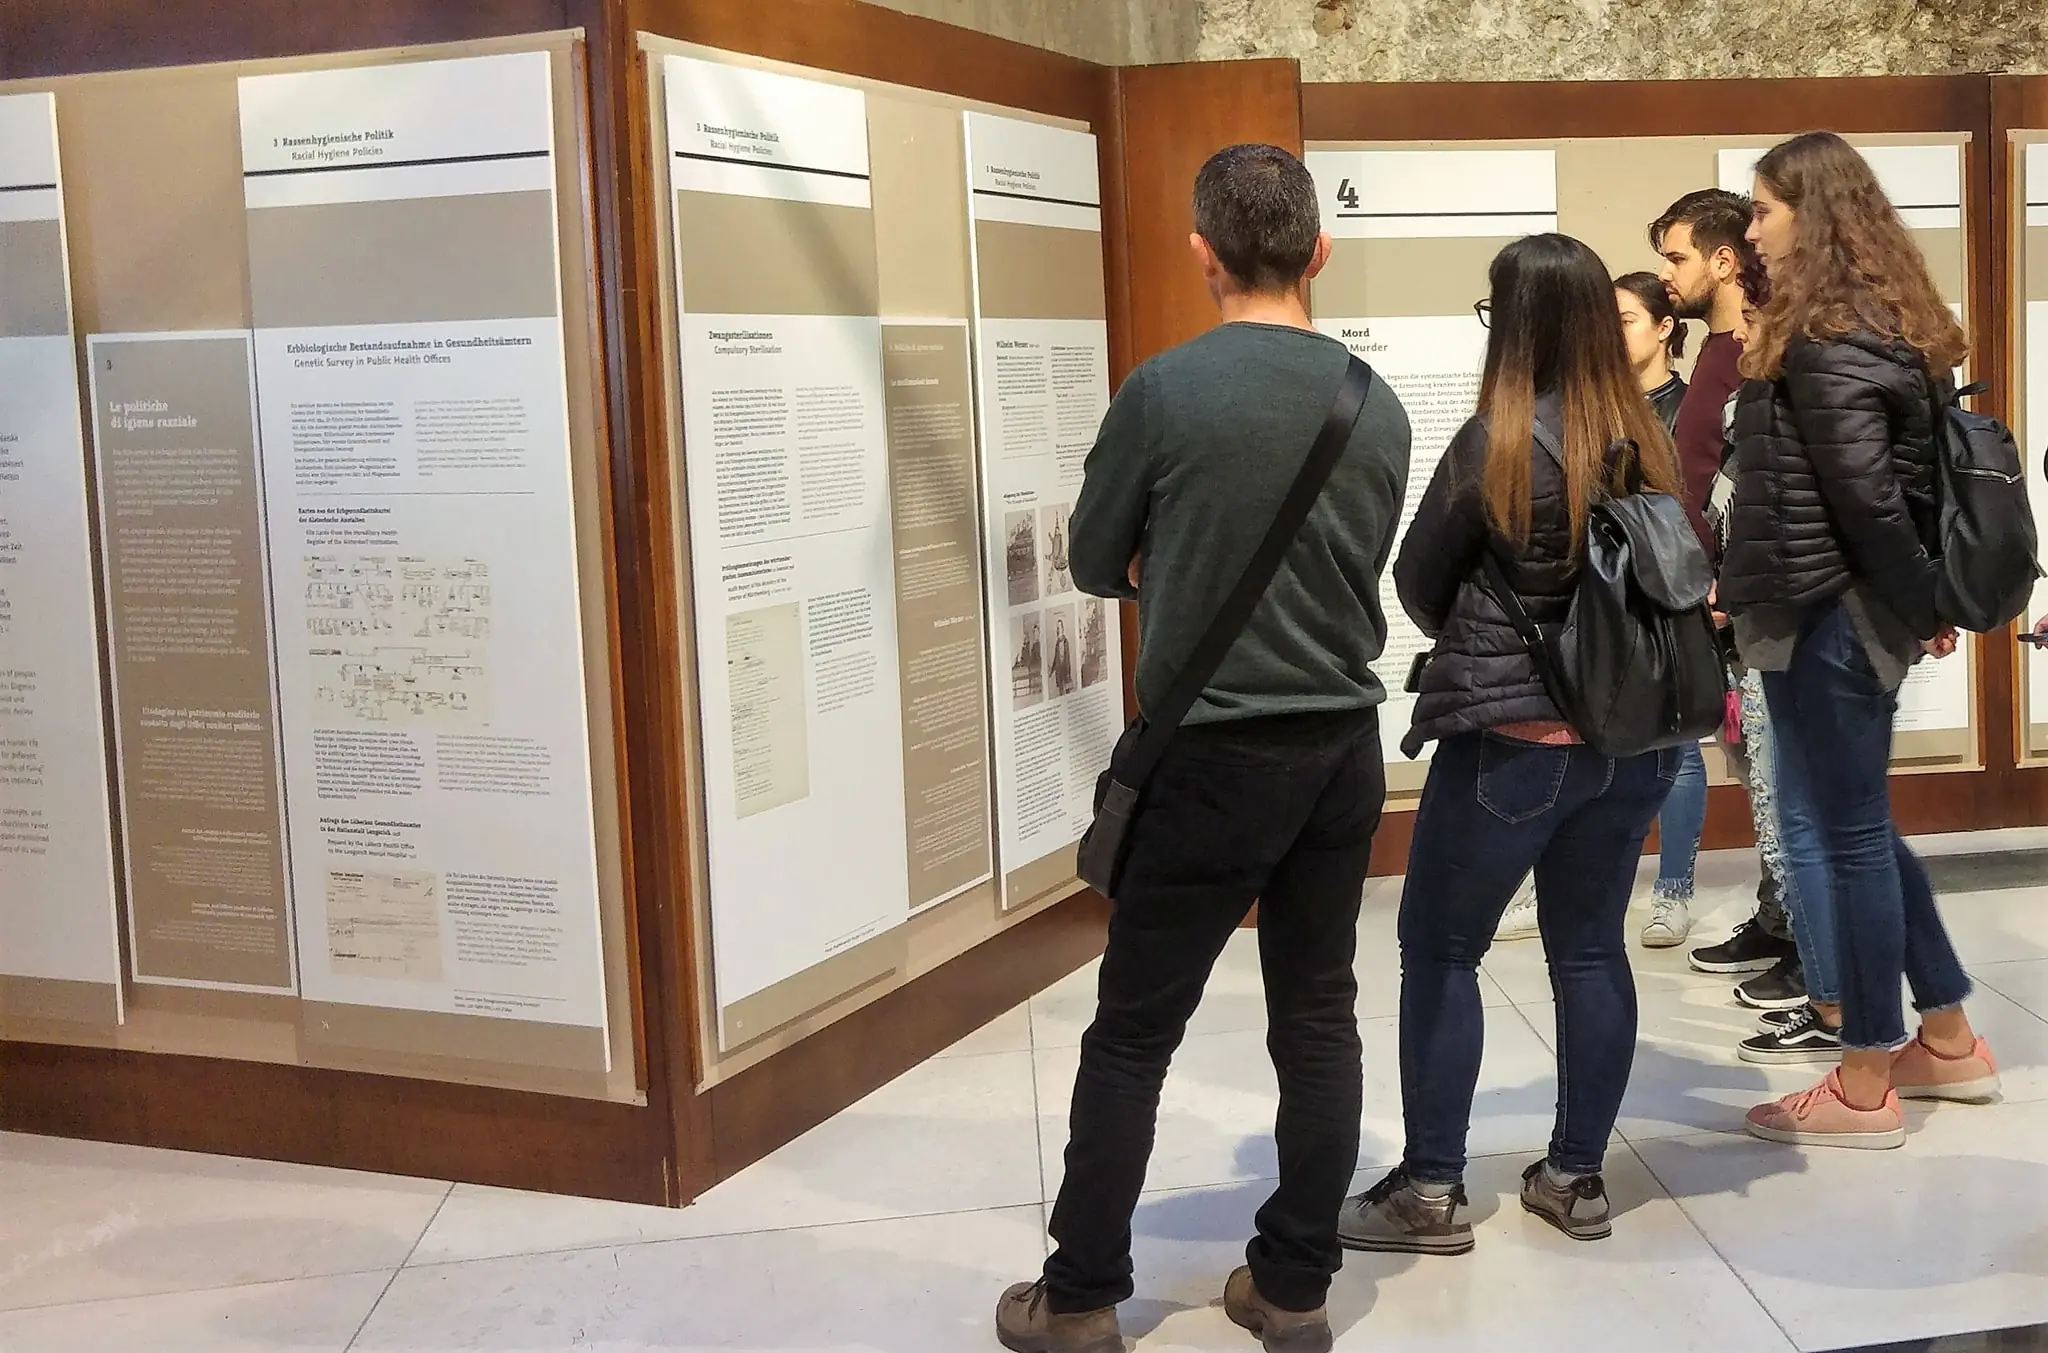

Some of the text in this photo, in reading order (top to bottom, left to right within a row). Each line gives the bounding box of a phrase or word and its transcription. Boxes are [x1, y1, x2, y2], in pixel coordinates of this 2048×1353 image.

[273, 129, 395, 147] 3 Rassenhygienische Politik
[760, 131, 780, 143] Politik
[291, 146, 384, 161] Racial Hygiene Policies
[1337, 178, 1360, 209] 4
[1341, 328, 1370, 338] Mord
[286, 336, 533, 355] Erbbiologische Bestandsaufnahme in Gesundheitsämtern
[1350, 343, 1388, 352] Murder
[294, 353, 452, 369] Genetic Survey in Public Health Offices
[109, 399, 169, 416] Le politiche
[110, 415, 122, 429] di
[157, 415, 198, 429] razziale
